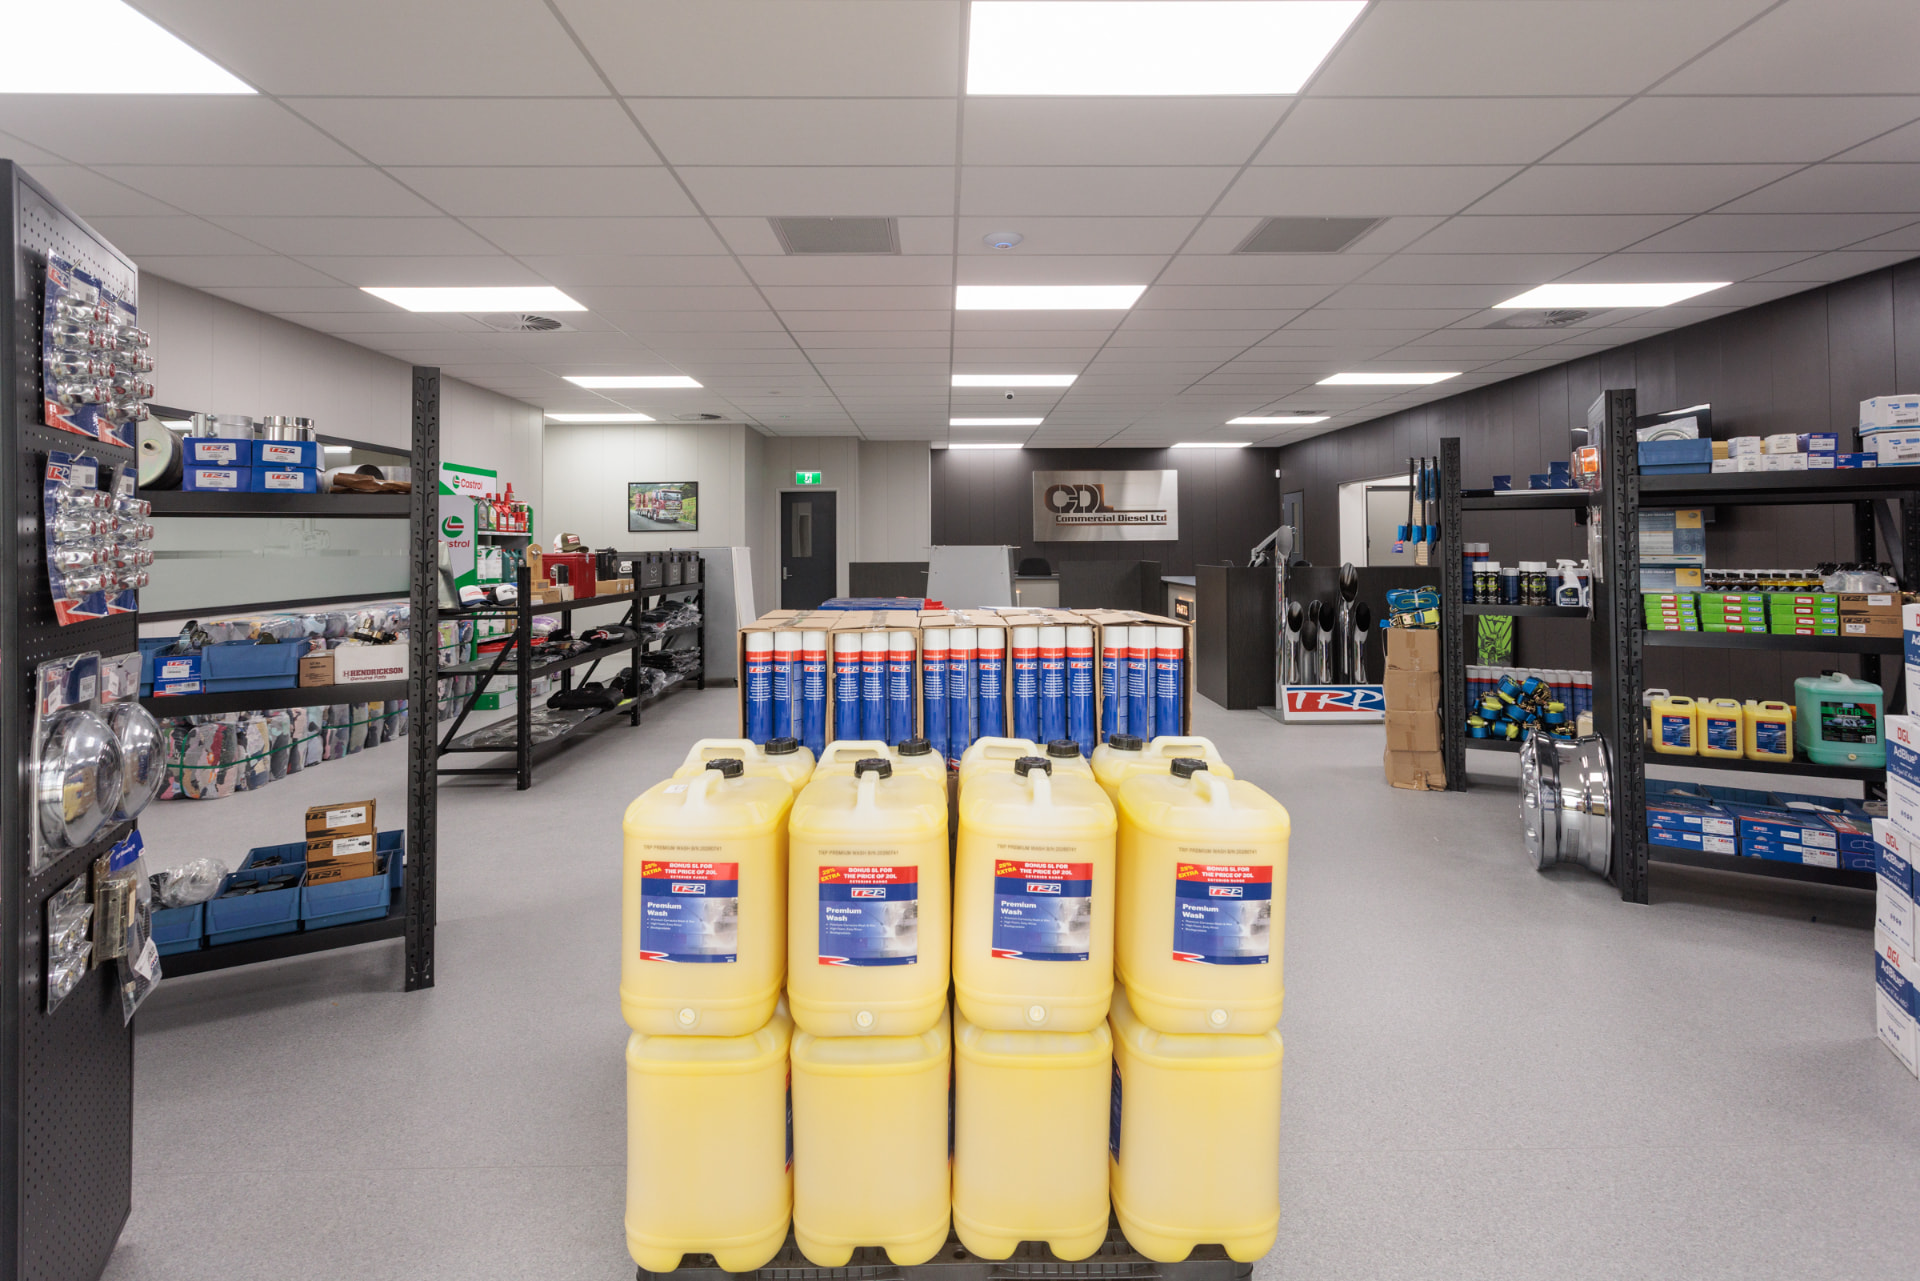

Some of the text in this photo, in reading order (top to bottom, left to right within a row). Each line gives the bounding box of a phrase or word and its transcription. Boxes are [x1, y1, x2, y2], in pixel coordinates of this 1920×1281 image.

[48, 464, 70, 480] TRP
[461, 479, 482, 490] Castrol
[1044, 484, 1114, 513] CDL
[350, 667, 403, 677] HENDRICKSON
[1290, 688, 1384, 711] TRP
[1836, 707, 1861, 716] CT18
[1897, 726, 1911, 744] DGL
[1886, 832, 1899, 851] DGL
[642, 867, 662, 876] EXTRA
[997, 866, 1017, 876] EXTRA
[1178, 870, 1199, 878] EXTRA
[820, 872, 841, 882] EXTRA
[673, 883, 705, 893] TRP
[852, 888, 885, 898] TRP
[1027, 883, 1060, 893] TRP
[1210, 886, 1242, 897] TRP
[1001, 900, 1036, 908] Premium
[1182, 904, 1219, 912] Premium
[1887, 945, 1900, 967] DGL
